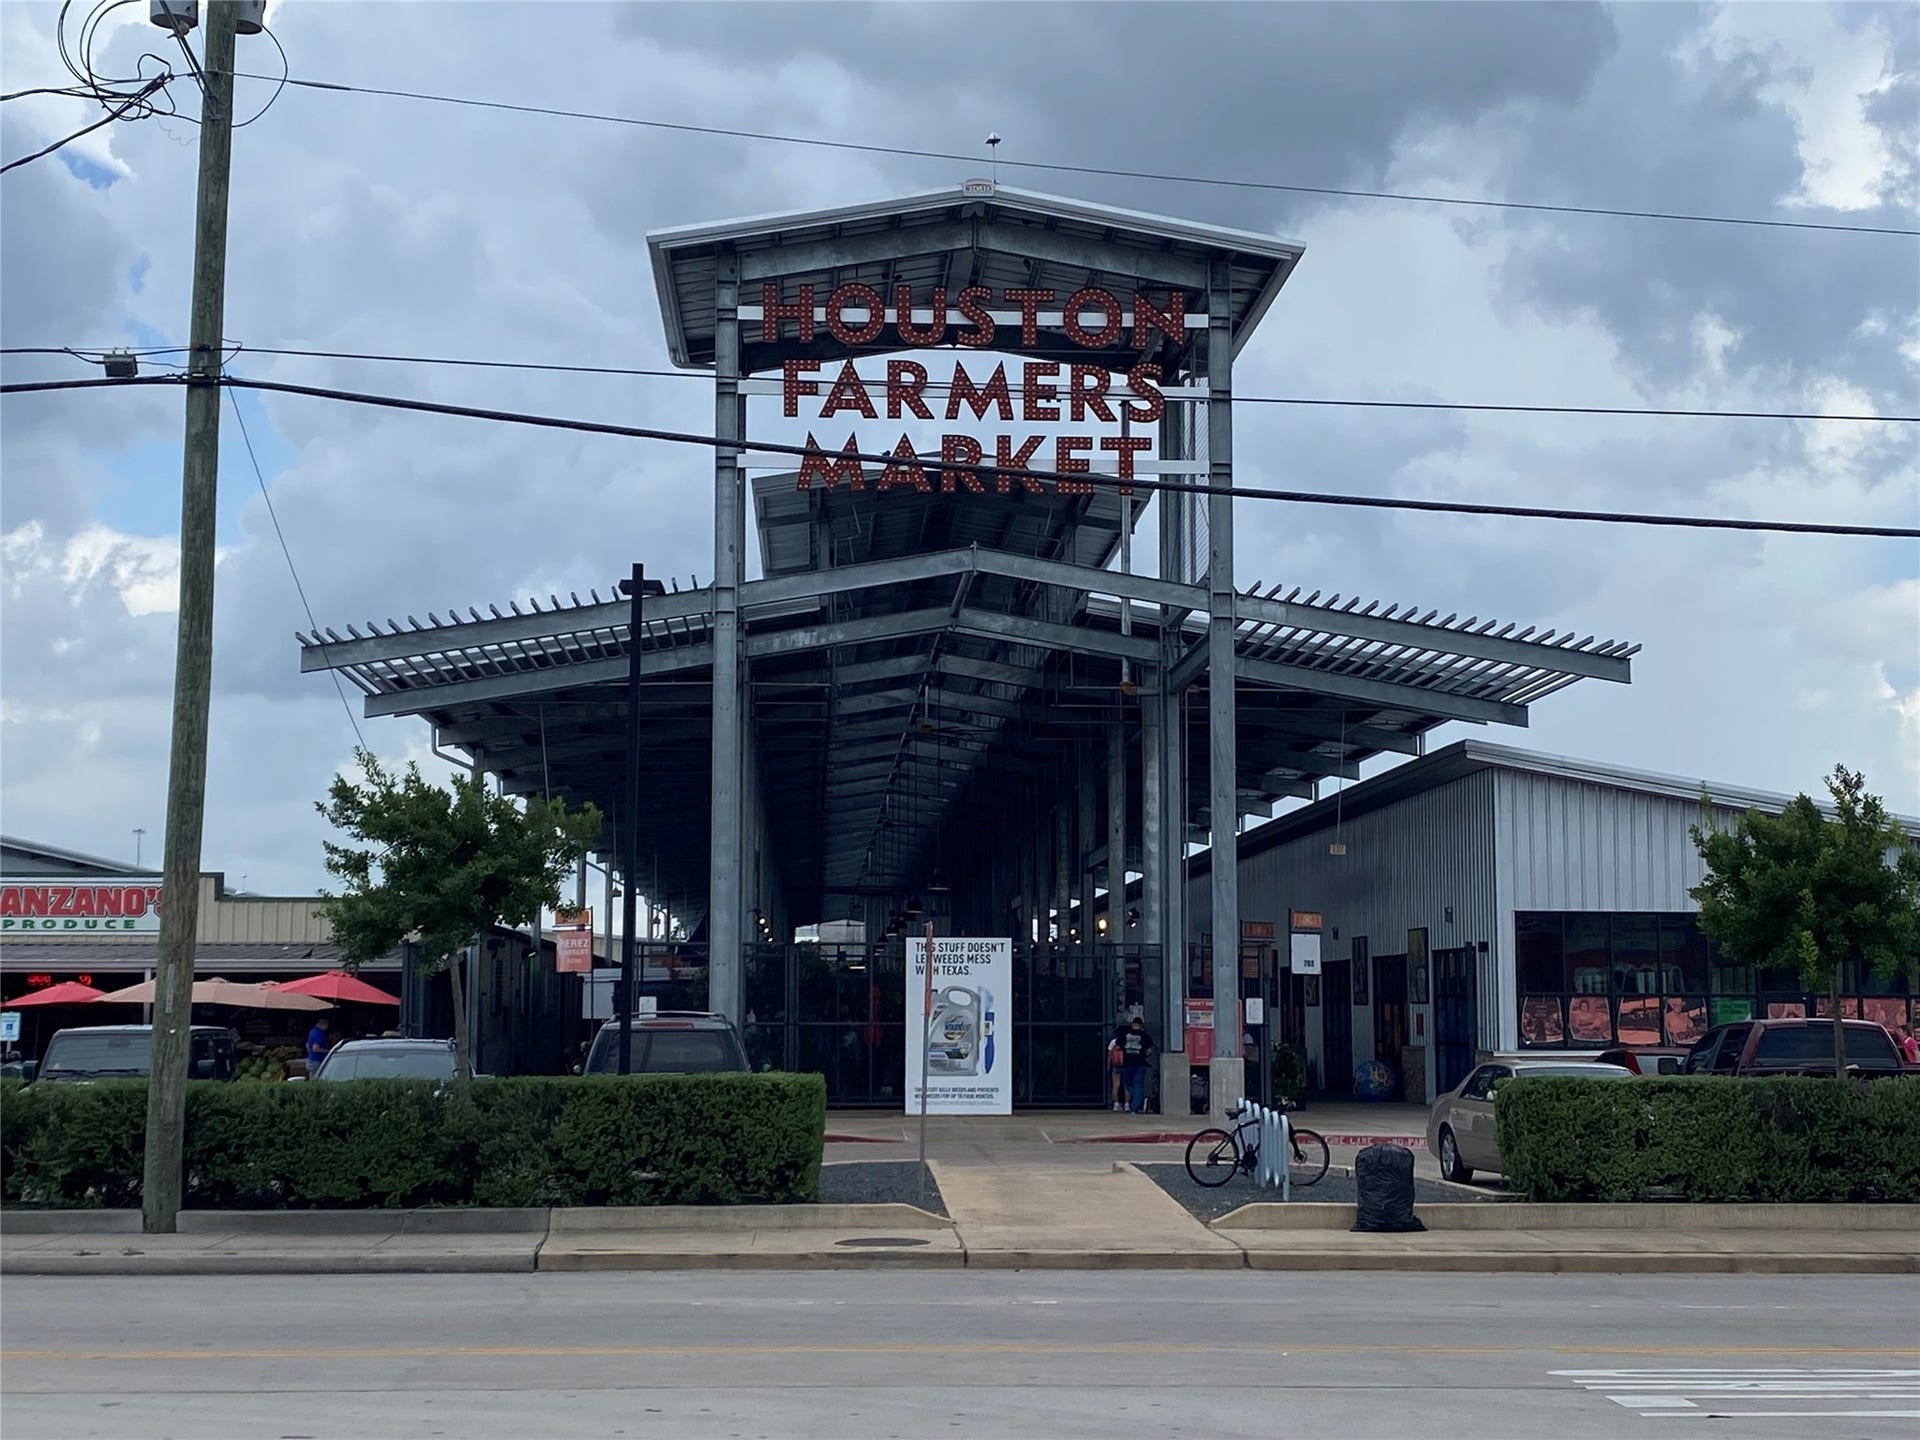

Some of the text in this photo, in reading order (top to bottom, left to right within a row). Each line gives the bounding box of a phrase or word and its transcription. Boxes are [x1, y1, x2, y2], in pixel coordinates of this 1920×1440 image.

[762, 282, 1186, 350] HOUSTON
[783, 359, 1166, 423] FARMERS
[796, 431, 1153, 496] MARKET
[2, 919, 136, 930] PRODUCE
[915, 942, 1006, 953] THS STUFF DOESN'T
[932, 953, 965, 964] WEEDS
[967, 953, 992, 964] MESS
[915, 965, 972, 975] WH TEXAS.
